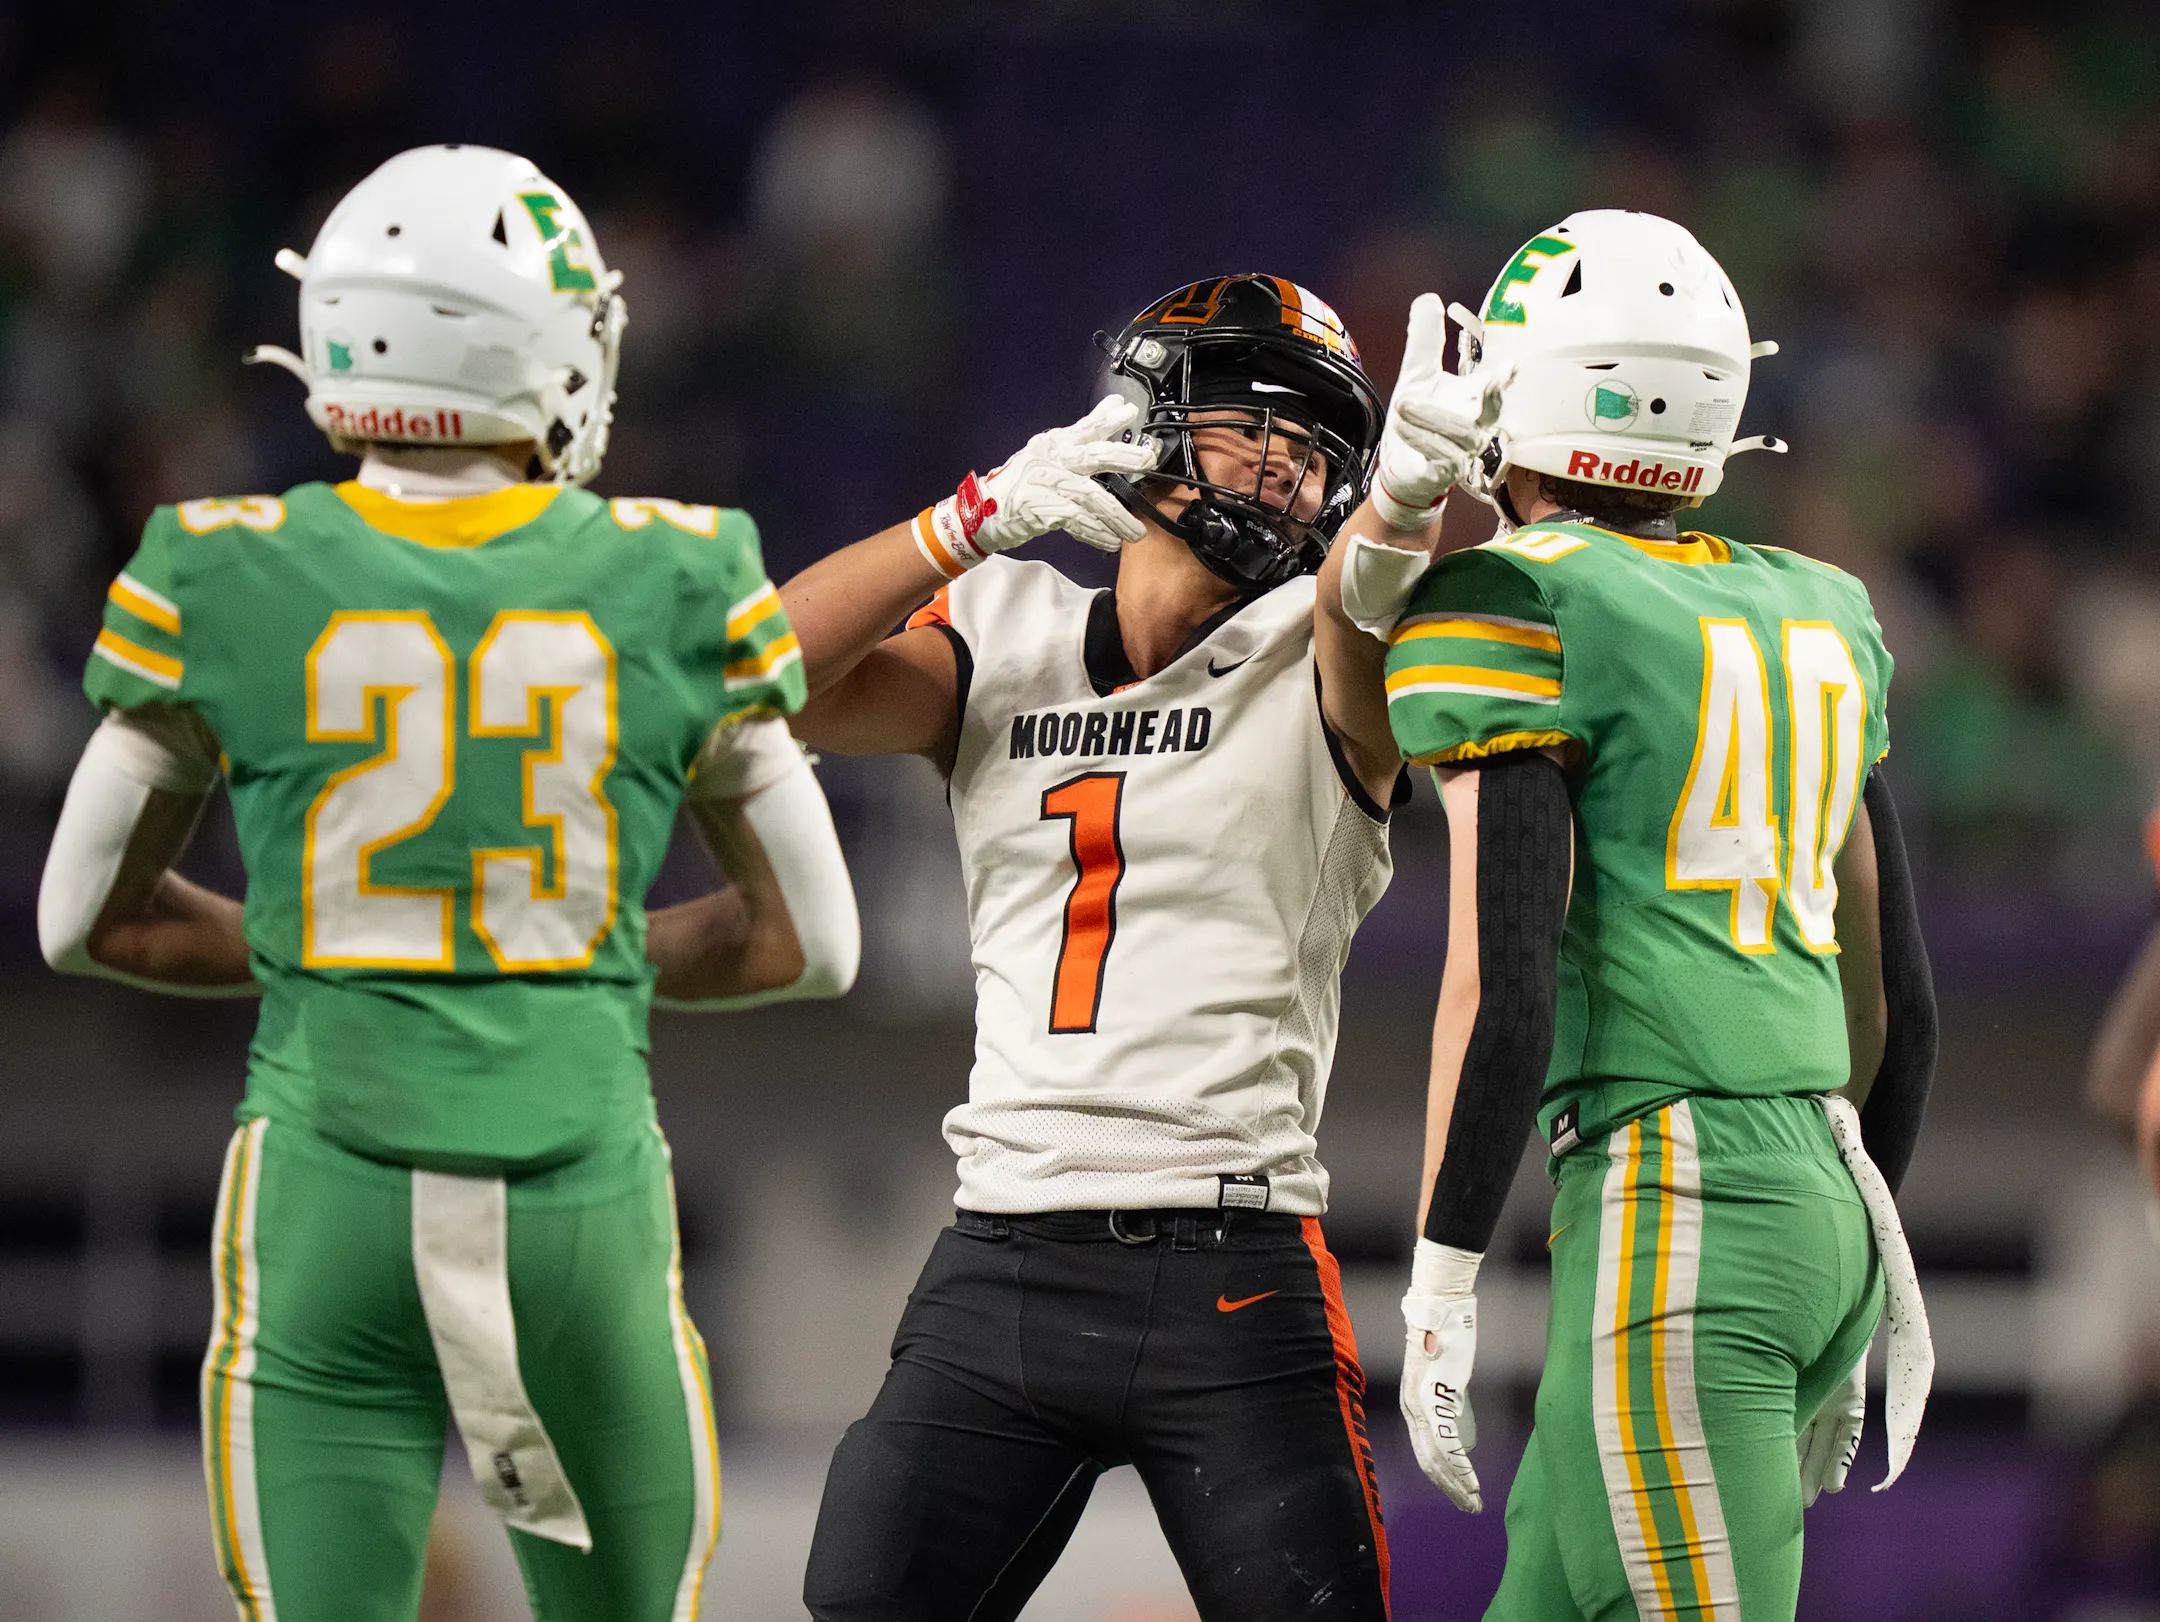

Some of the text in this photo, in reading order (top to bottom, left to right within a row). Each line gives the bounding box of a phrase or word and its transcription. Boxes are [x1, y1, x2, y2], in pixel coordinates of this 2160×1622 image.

[516, 191, 598, 294] E
[1483, 235, 1576, 326] E
[1567, 450, 1704, 492] Riddell
[1009, 707, 1212, 760] MOORHEAD
[302, 610, 618, 972] 23
[1665, 616, 1867, 955] 40
[1040, 771, 1127, 1034] 1
[1557, 1113, 1569, 1134] M
[1434, 1381, 1475, 1477] VAPOR
